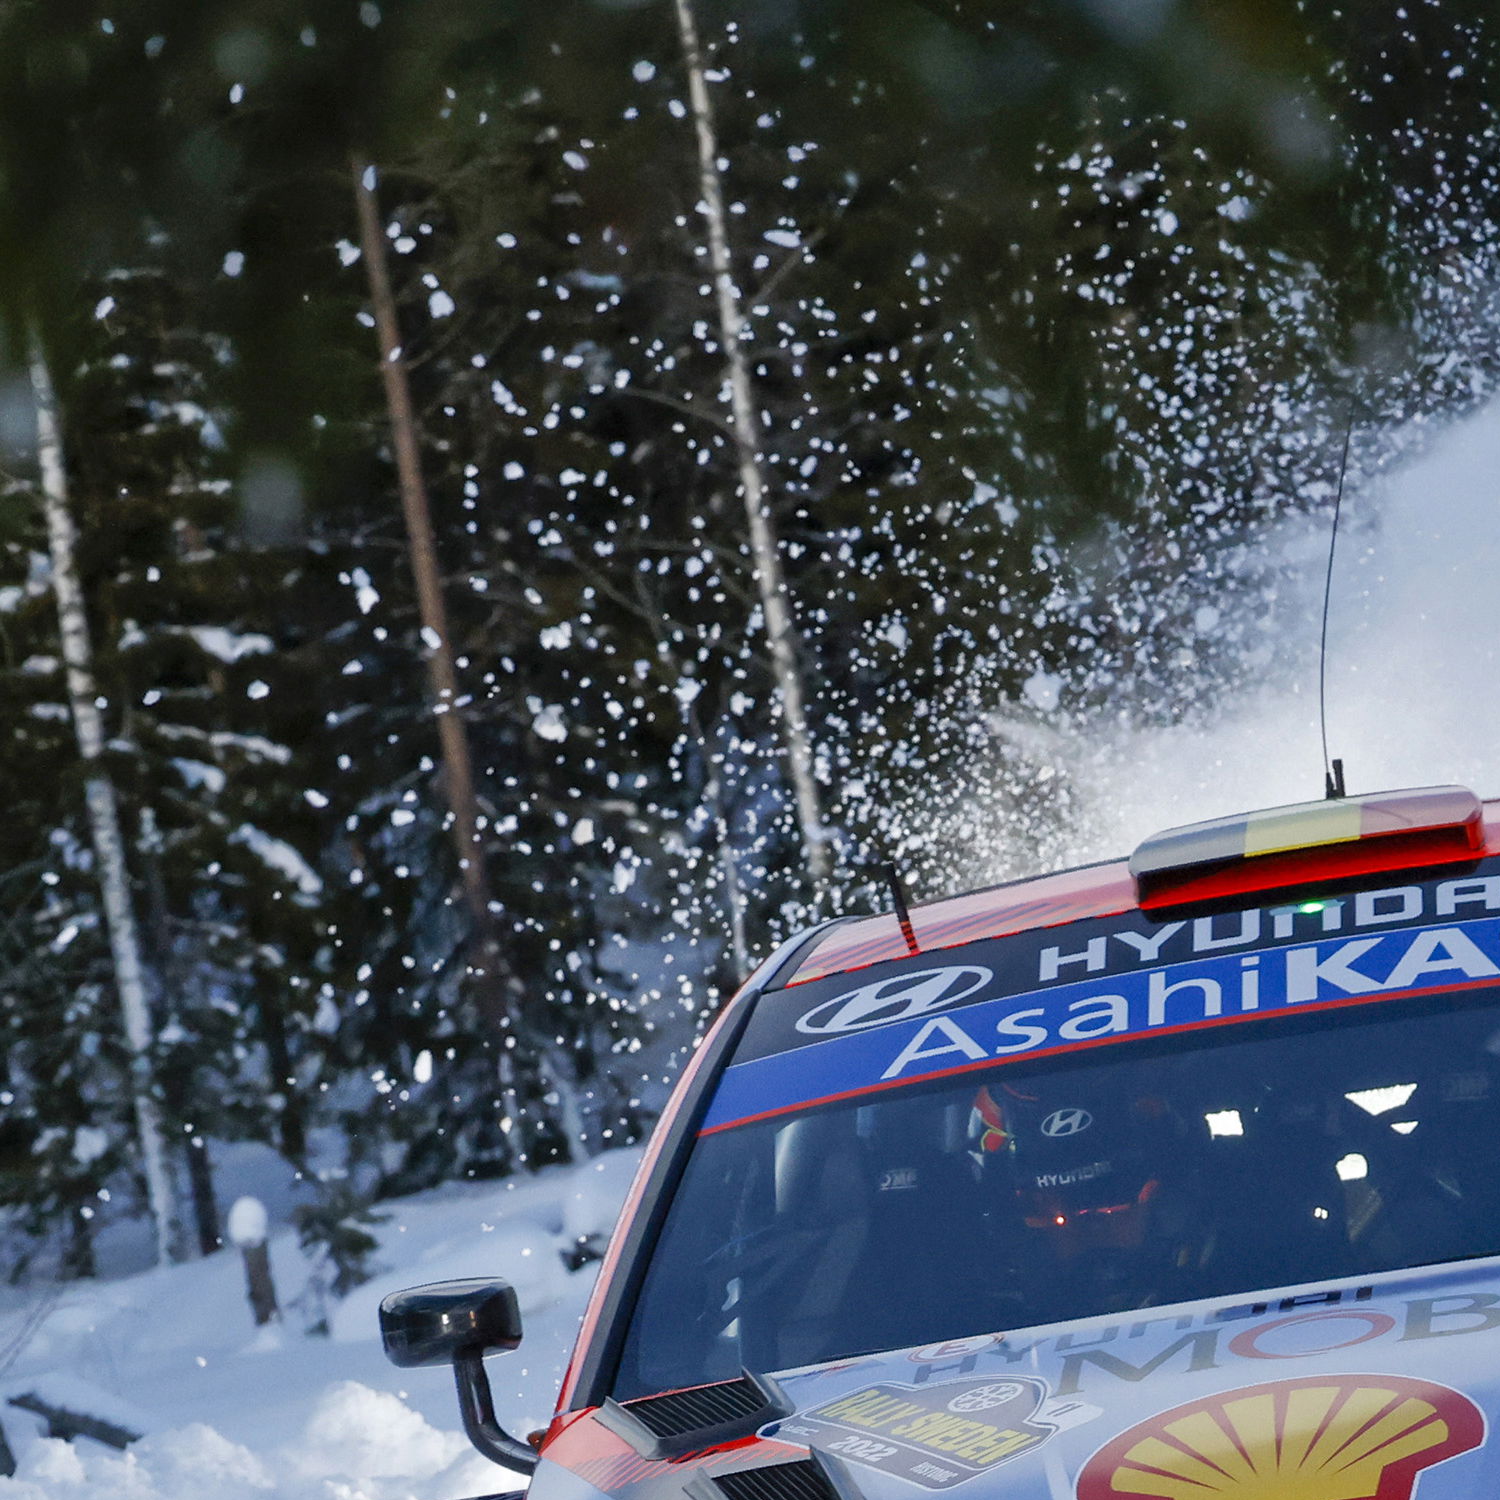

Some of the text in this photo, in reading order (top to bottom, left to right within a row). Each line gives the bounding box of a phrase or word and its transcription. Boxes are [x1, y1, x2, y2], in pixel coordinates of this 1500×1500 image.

[816, 1388, 1042, 1466] RALLY SWEDEN
[827, 1435, 900, 1463] 2022
